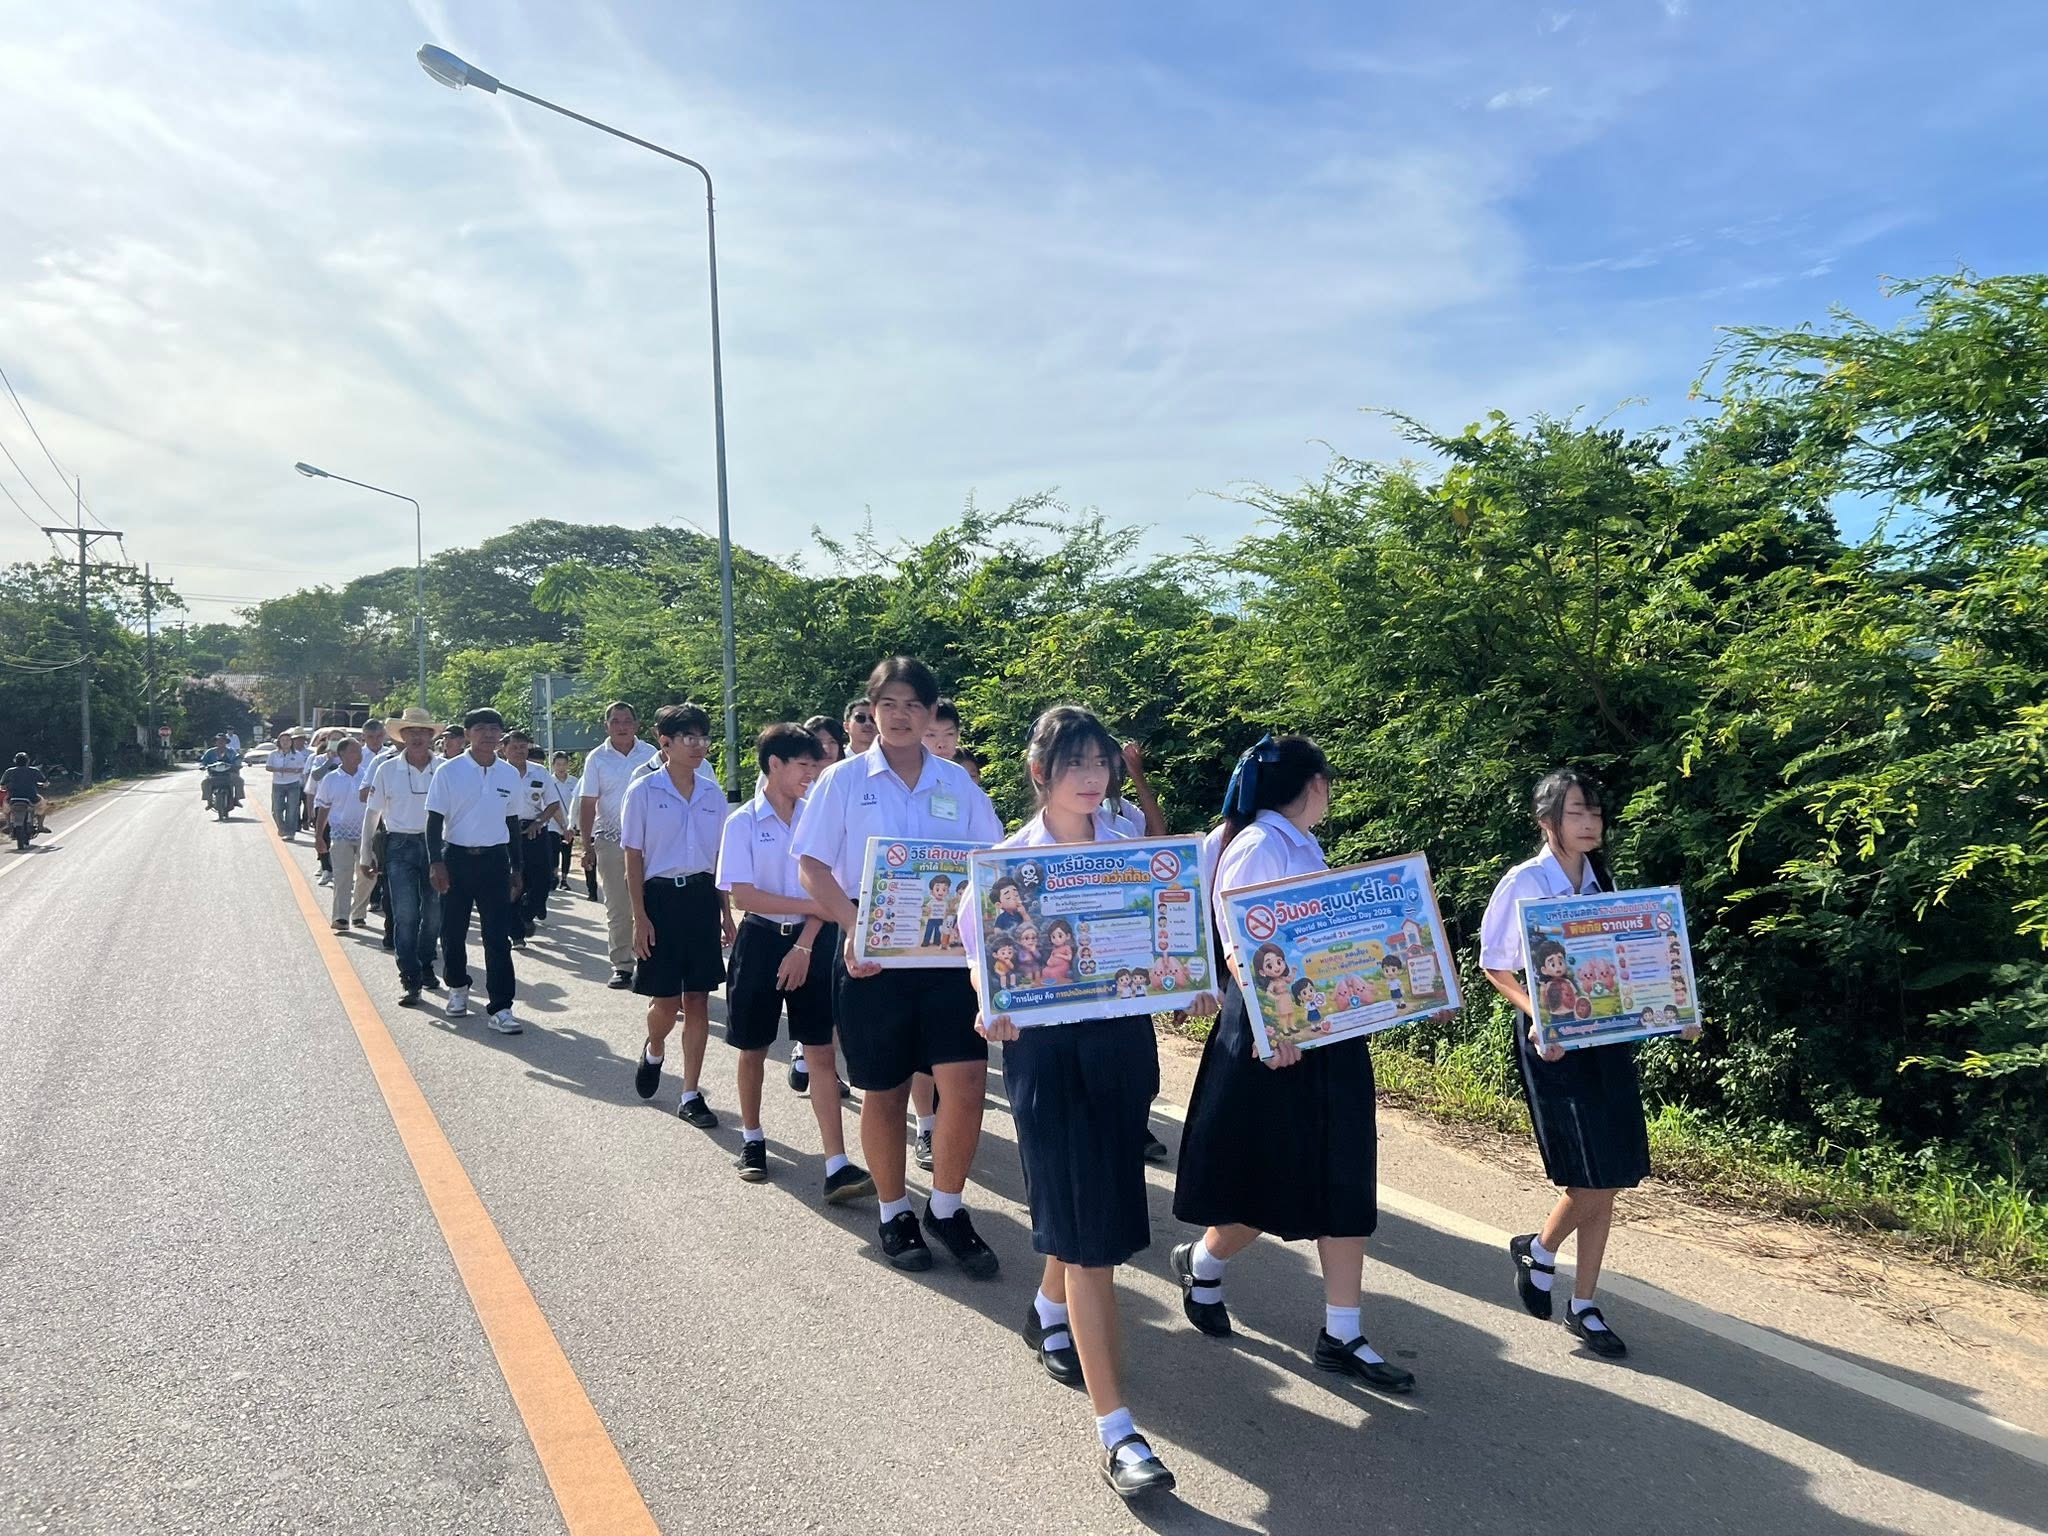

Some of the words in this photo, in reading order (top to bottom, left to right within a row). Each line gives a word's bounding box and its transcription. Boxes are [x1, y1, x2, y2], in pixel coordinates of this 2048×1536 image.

[911, 846, 969, 865] วิธีเลิกบุห
[1047, 855, 1125, 877] บุหรี่มือสอง
[1046, 866, 1151, 890] อันตรายกว่าที่คิด
[1276, 878, 1404, 923] วันงดสูบบุหรี่โลก
[1294, 923, 1316, 935] World
[1317, 920, 1328, 929] No
[1328, 914, 1357, 926] Tobacco
[1359, 911, 1372, 920] Day
